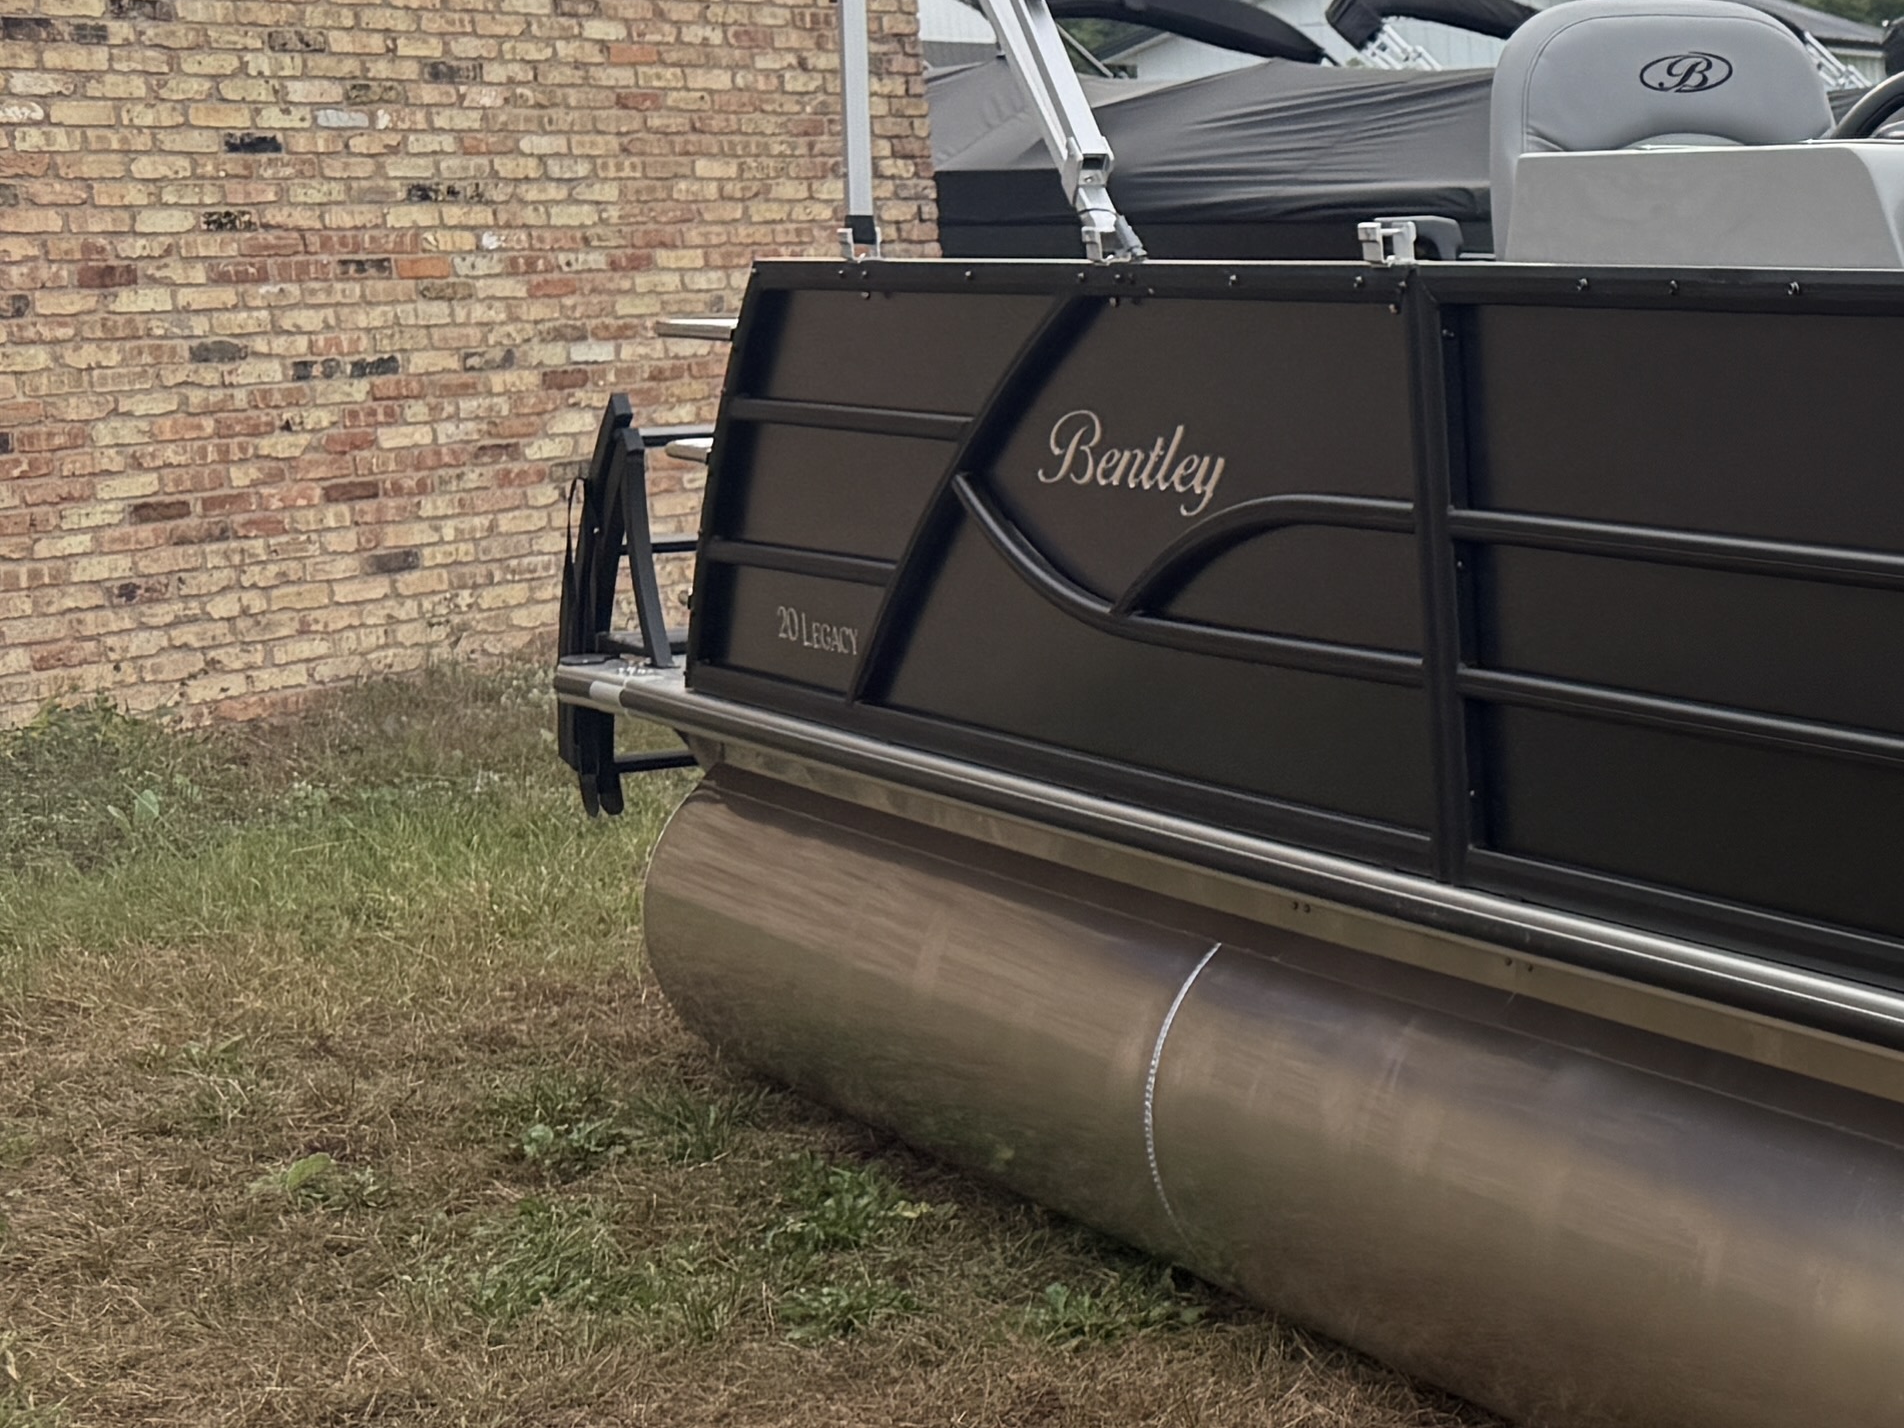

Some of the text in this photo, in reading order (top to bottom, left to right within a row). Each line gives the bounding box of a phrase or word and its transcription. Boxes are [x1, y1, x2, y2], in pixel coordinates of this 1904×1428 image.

[1656, 54, 1714, 92] B
[1038, 409, 1225, 516] Bentley
[777, 605, 799, 641] 20
